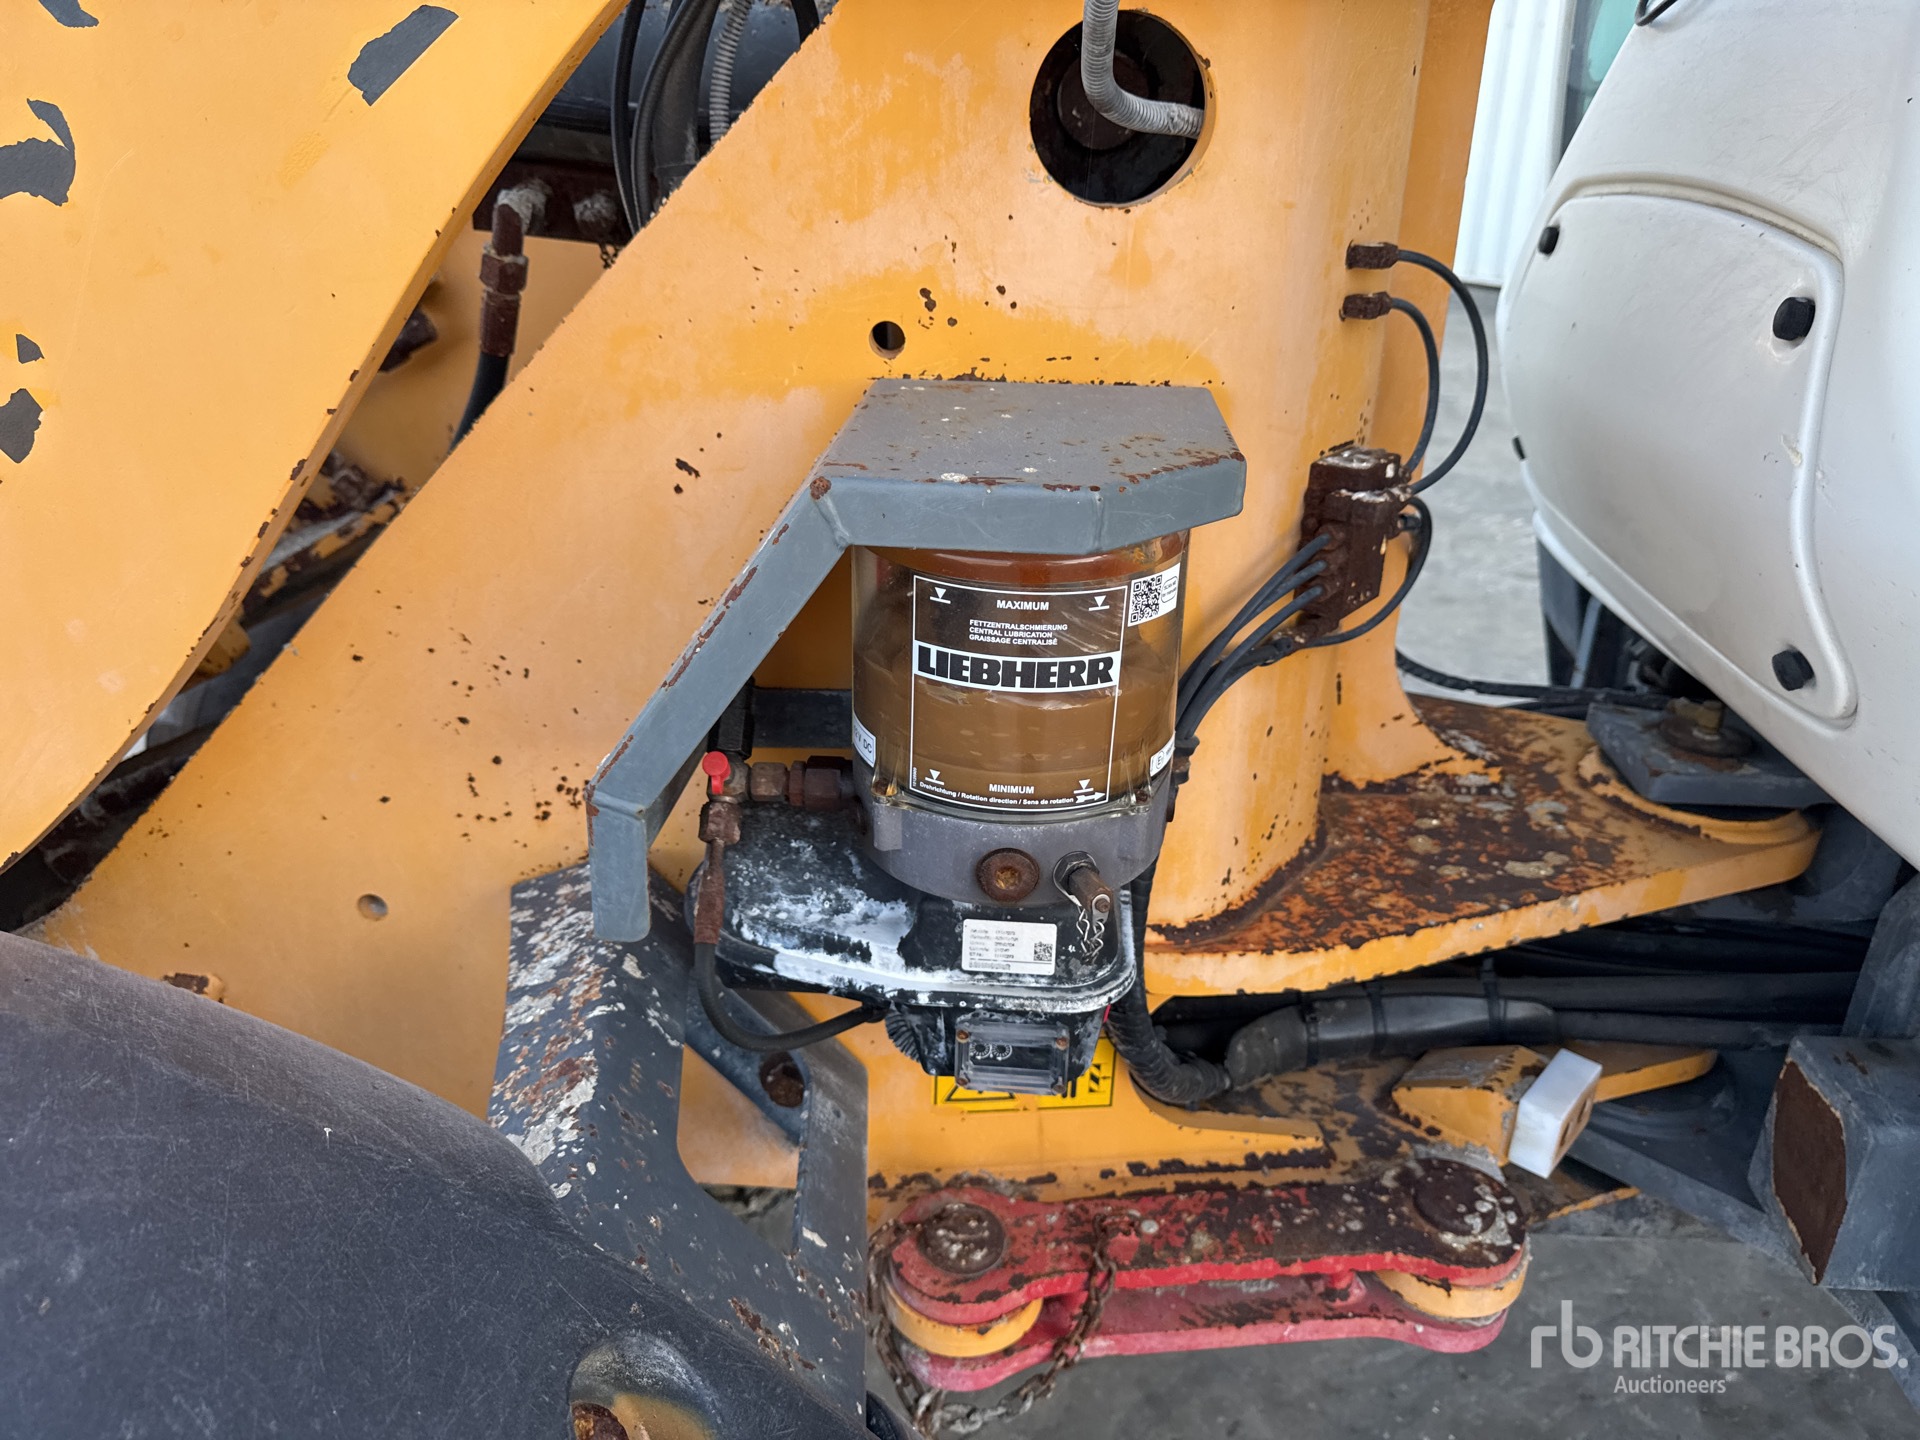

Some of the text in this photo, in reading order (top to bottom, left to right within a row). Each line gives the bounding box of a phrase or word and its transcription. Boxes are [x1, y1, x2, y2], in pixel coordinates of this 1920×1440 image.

[996, 599, 1049, 611] MAXIMUM
[969, 619, 1068, 631] FETTZENTRALSCHMIERUNG
[969, 626, 1053, 638] CENTRAL LUBRICATION
[969, 634, 1058, 646] GRAISSAGE CENTRALISÉ
[917, 644, 1114, 689] LIEBHERR
[863, 738, 873, 754] DC
[919, 781, 957, 798] Drehrichtung
[961, 792, 988, 802] Rotation
[988, 797, 1018, 805] direction
[989, 783, 1035, 794] MINIMUM
